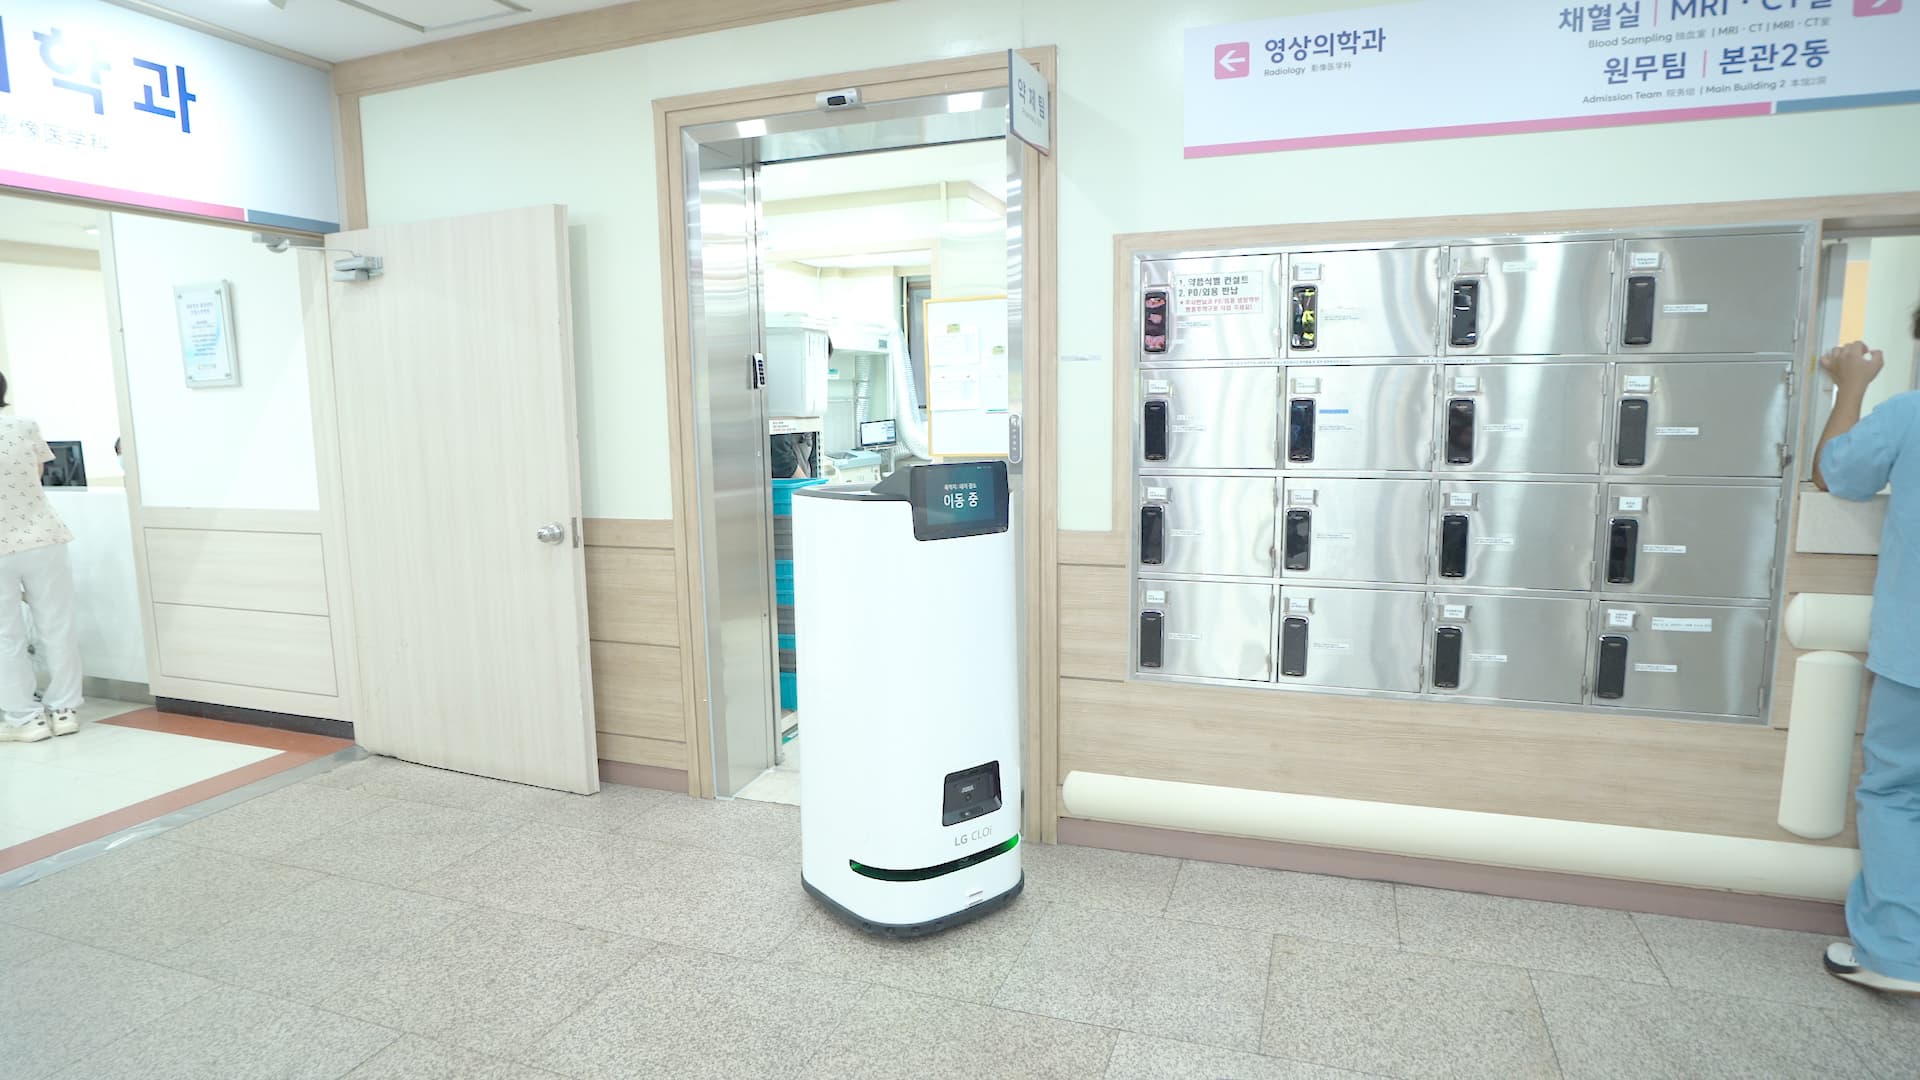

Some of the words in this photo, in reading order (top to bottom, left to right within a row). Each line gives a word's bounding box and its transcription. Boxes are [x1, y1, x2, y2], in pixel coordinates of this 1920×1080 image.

[1558, 1, 1640, 32] 채혈실
[1265, 27, 1387, 63] 영상의학과
[1588, 37, 1618, 48] Blood
[1621, 32, 1673, 46] Sampling
[1718, 25, 1739, 35] MRI
[1749, 23, 1764, 33] CT
[1773, 19, 1795, 30] MRI
[0, 15, 196, 134] 학과
[1264, 66, 1306, 77] Radiology
[1604, 51, 1687, 85] 원무팀
[1719, 39, 1830, 75] 본관2동
[1582, 93, 1633, 104] Admission
[1634, 90, 1662, 99] Team
[1705, 84, 1732, 94] Main
[1733, 80, 1777, 92] Building
[1779, 79, 1786, 88] 2
[943, 492, 966, 509] 이동
[968, 491, 979, 507] 중
[954, 834, 968, 846] LG
